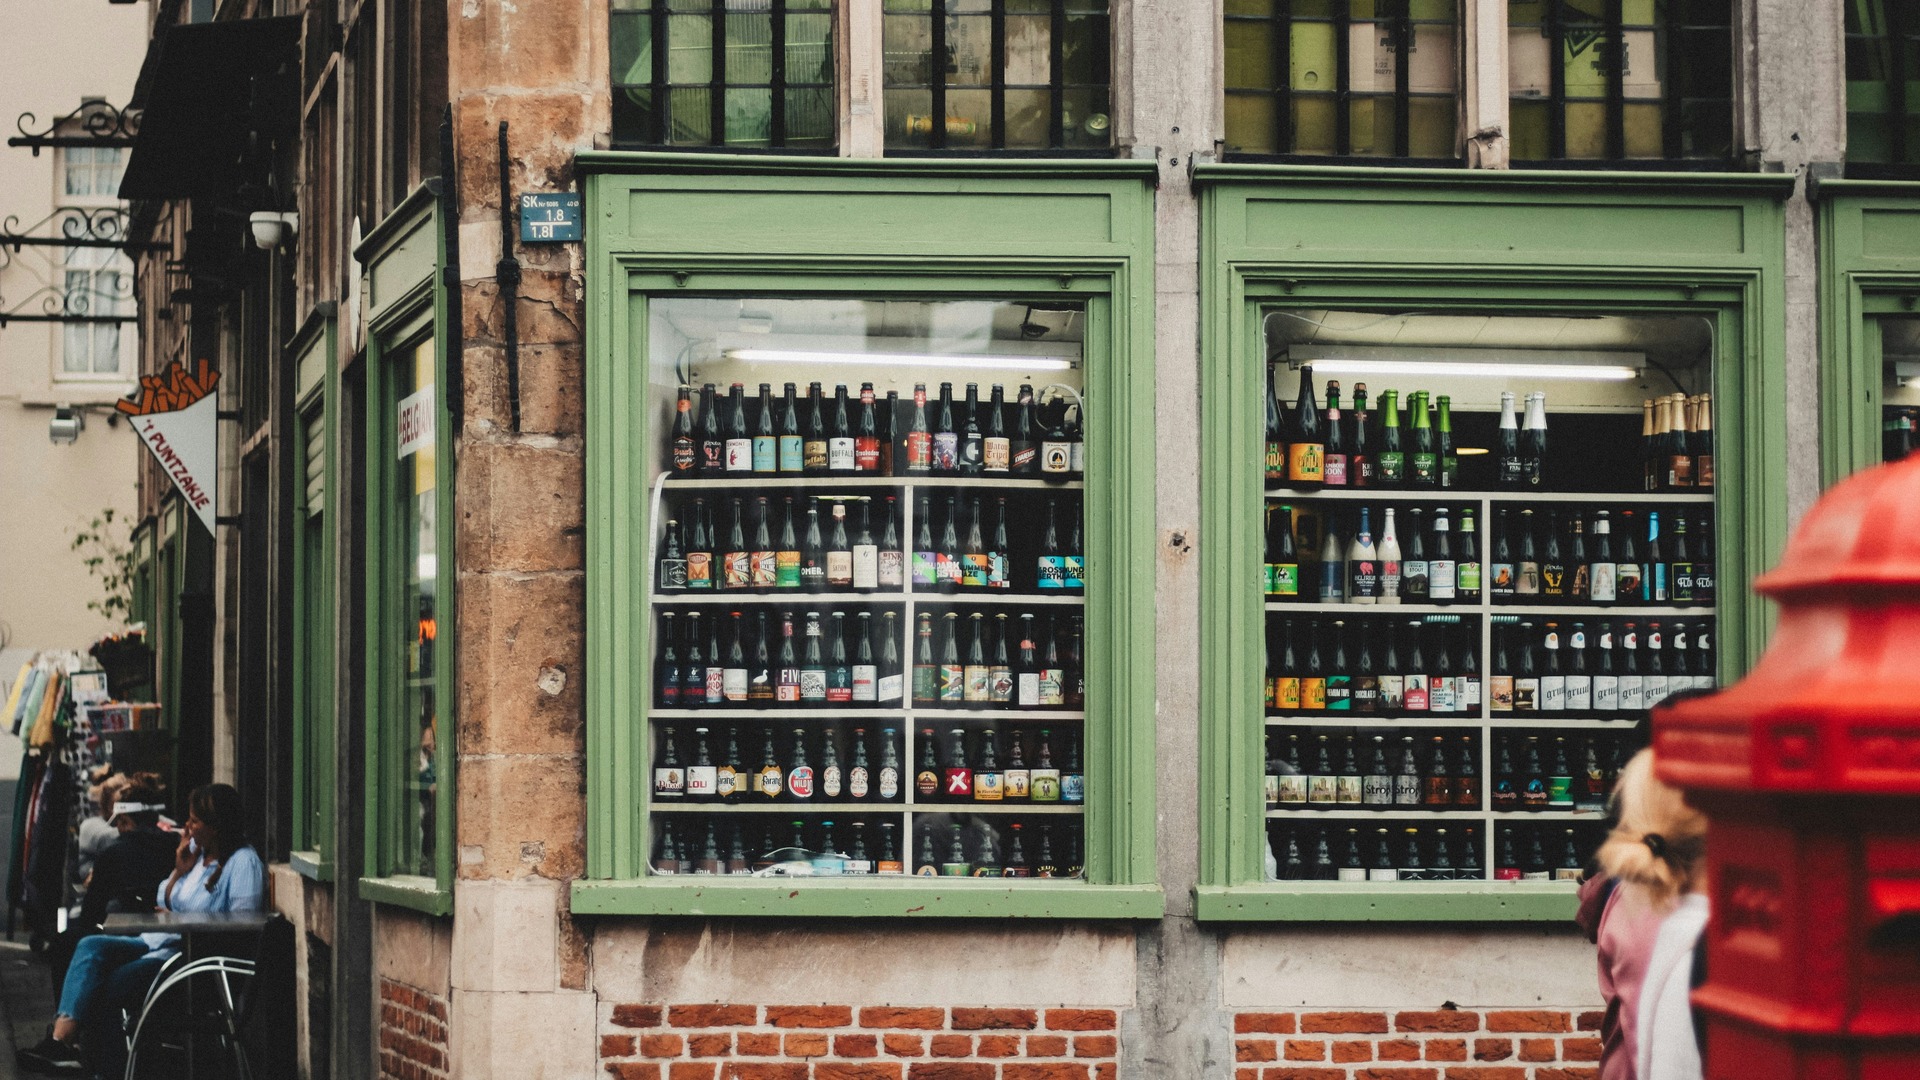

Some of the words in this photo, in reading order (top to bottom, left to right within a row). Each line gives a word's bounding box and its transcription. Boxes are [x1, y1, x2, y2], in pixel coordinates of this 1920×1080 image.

[523, 196, 538, 208] SK
[986, 441, 1008, 450] Watou
[830, 450, 854, 458] BUFFALO
[986, 451, 1008, 461] Tripel
[149, 432, 210, 511] PUNTZAKJE
[936, 561, 960, 570] DARK
[801, 566, 824, 576] OMER.
